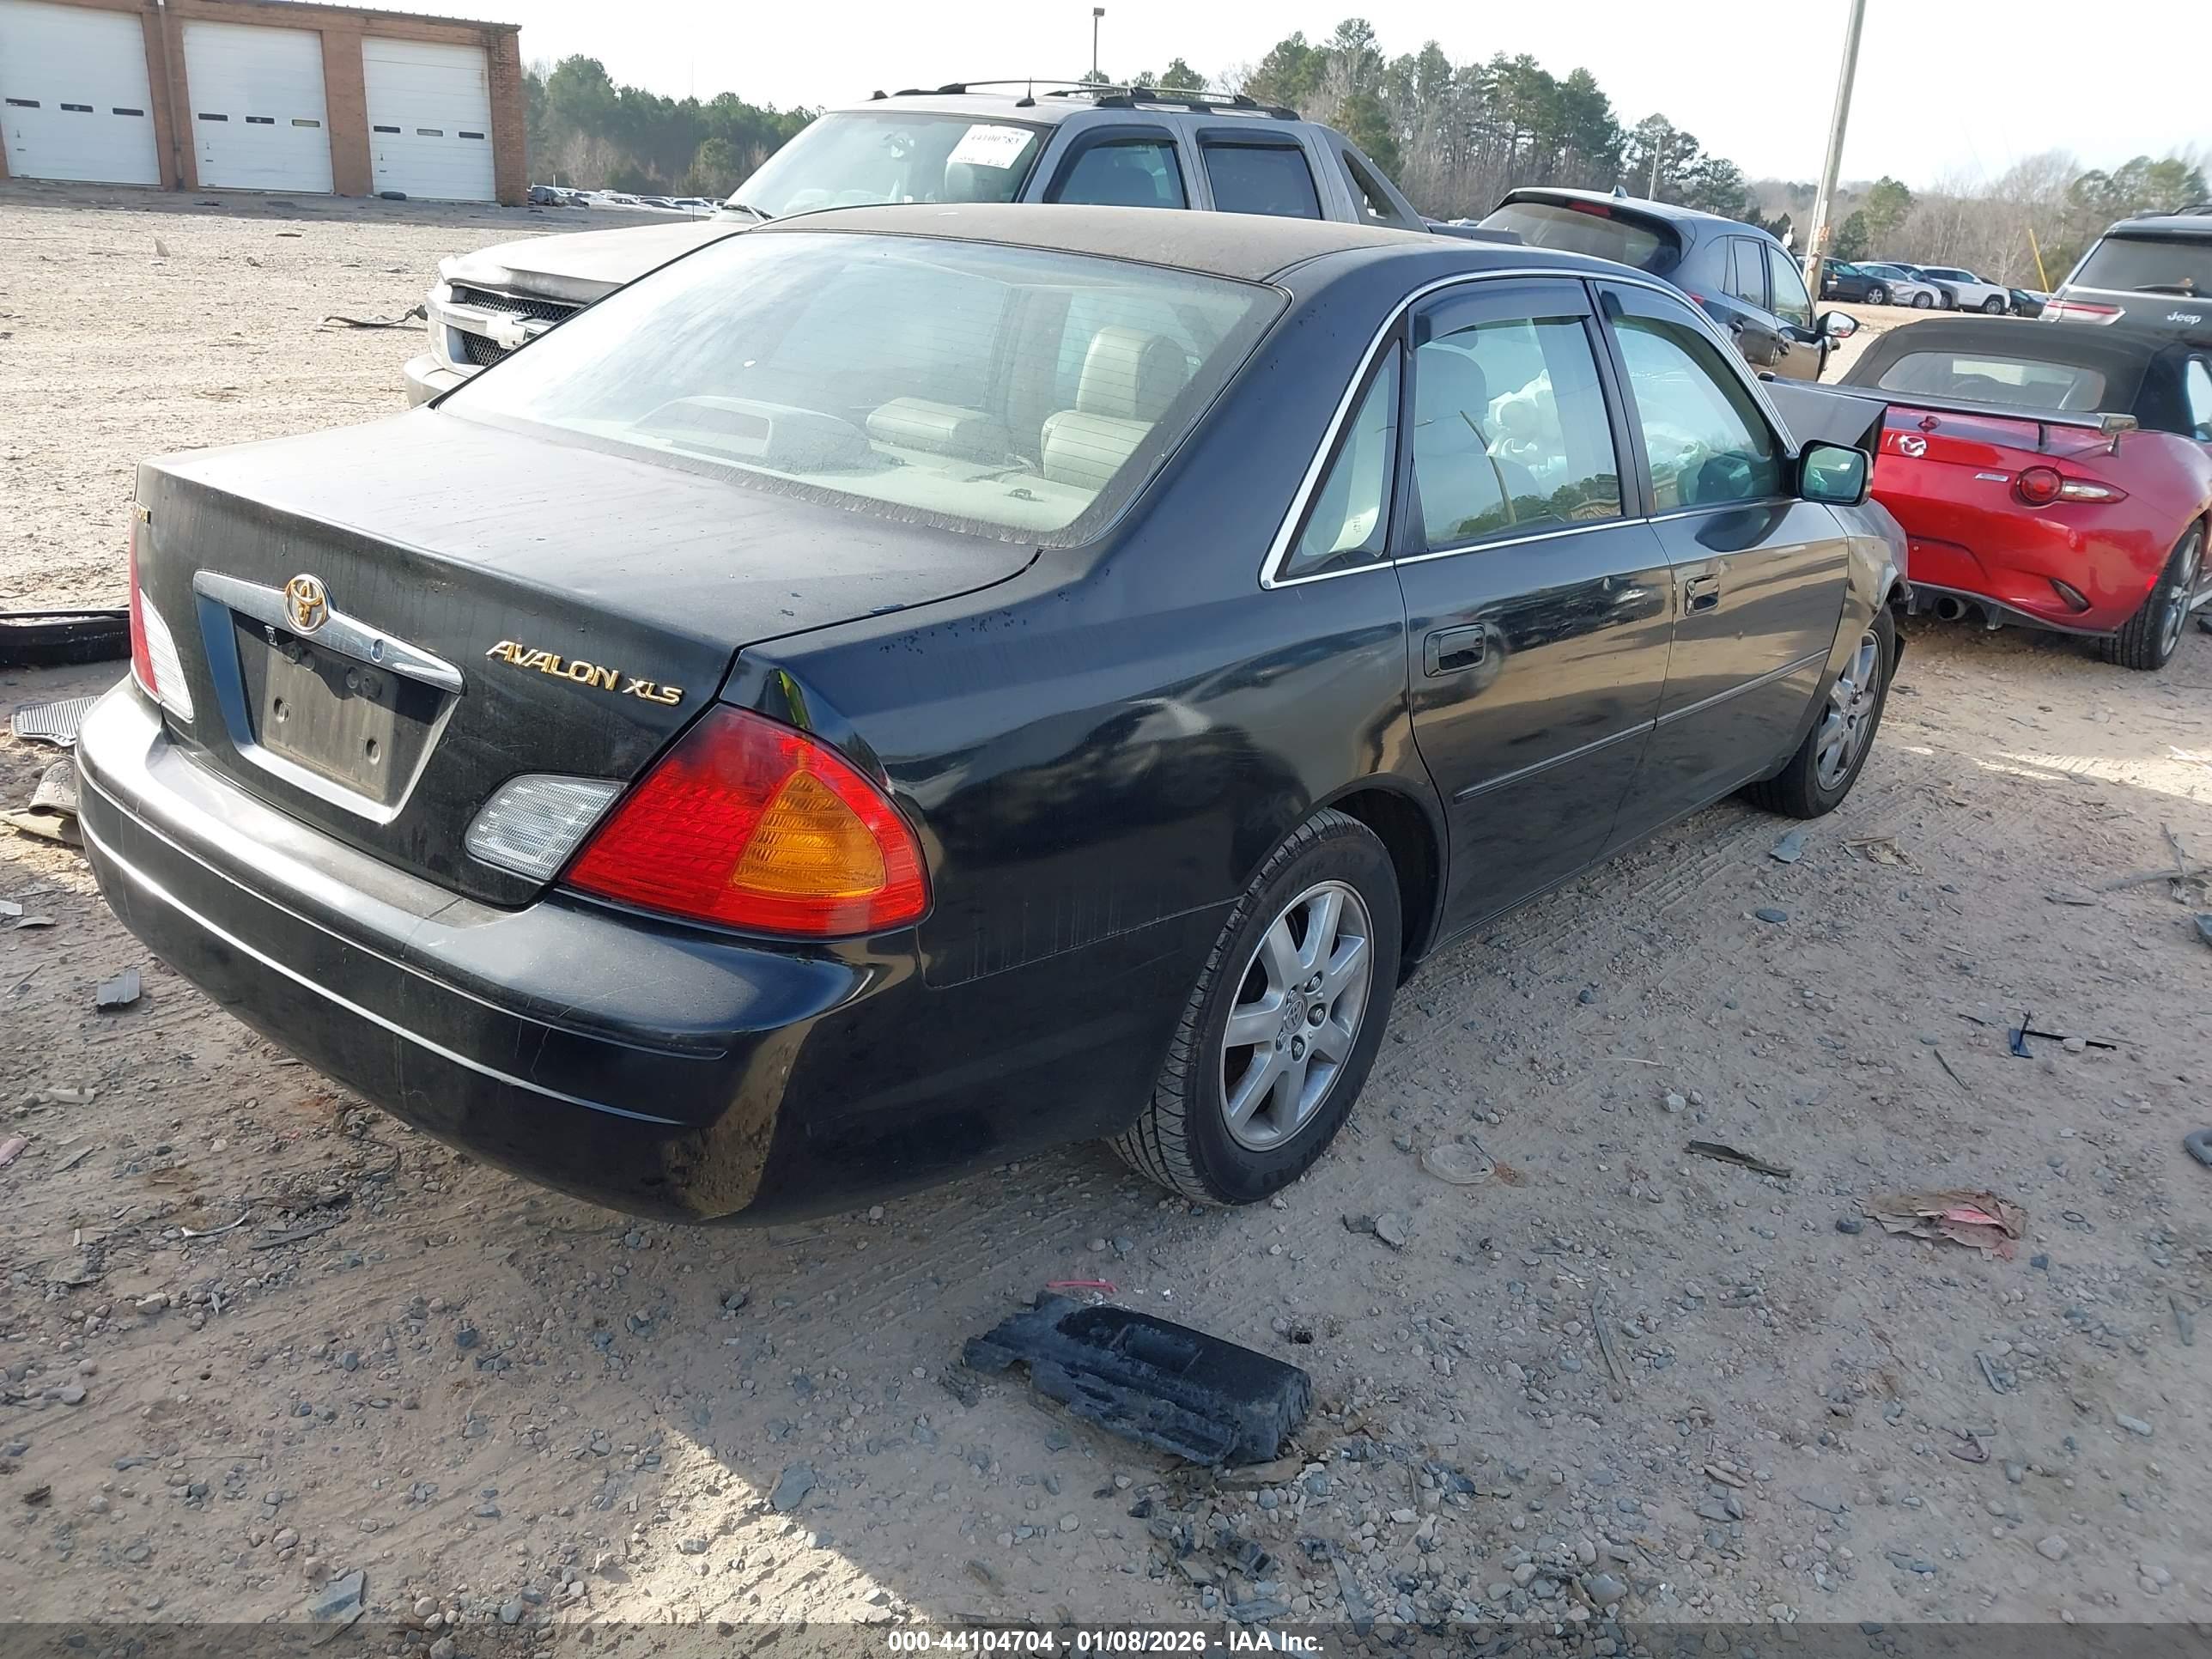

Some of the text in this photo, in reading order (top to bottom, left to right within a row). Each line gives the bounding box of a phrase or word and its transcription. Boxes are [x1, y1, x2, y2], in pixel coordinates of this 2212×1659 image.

[2166, 311, 2203, 325] Jeep
[485, 641, 683, 706] AVALON XLS
